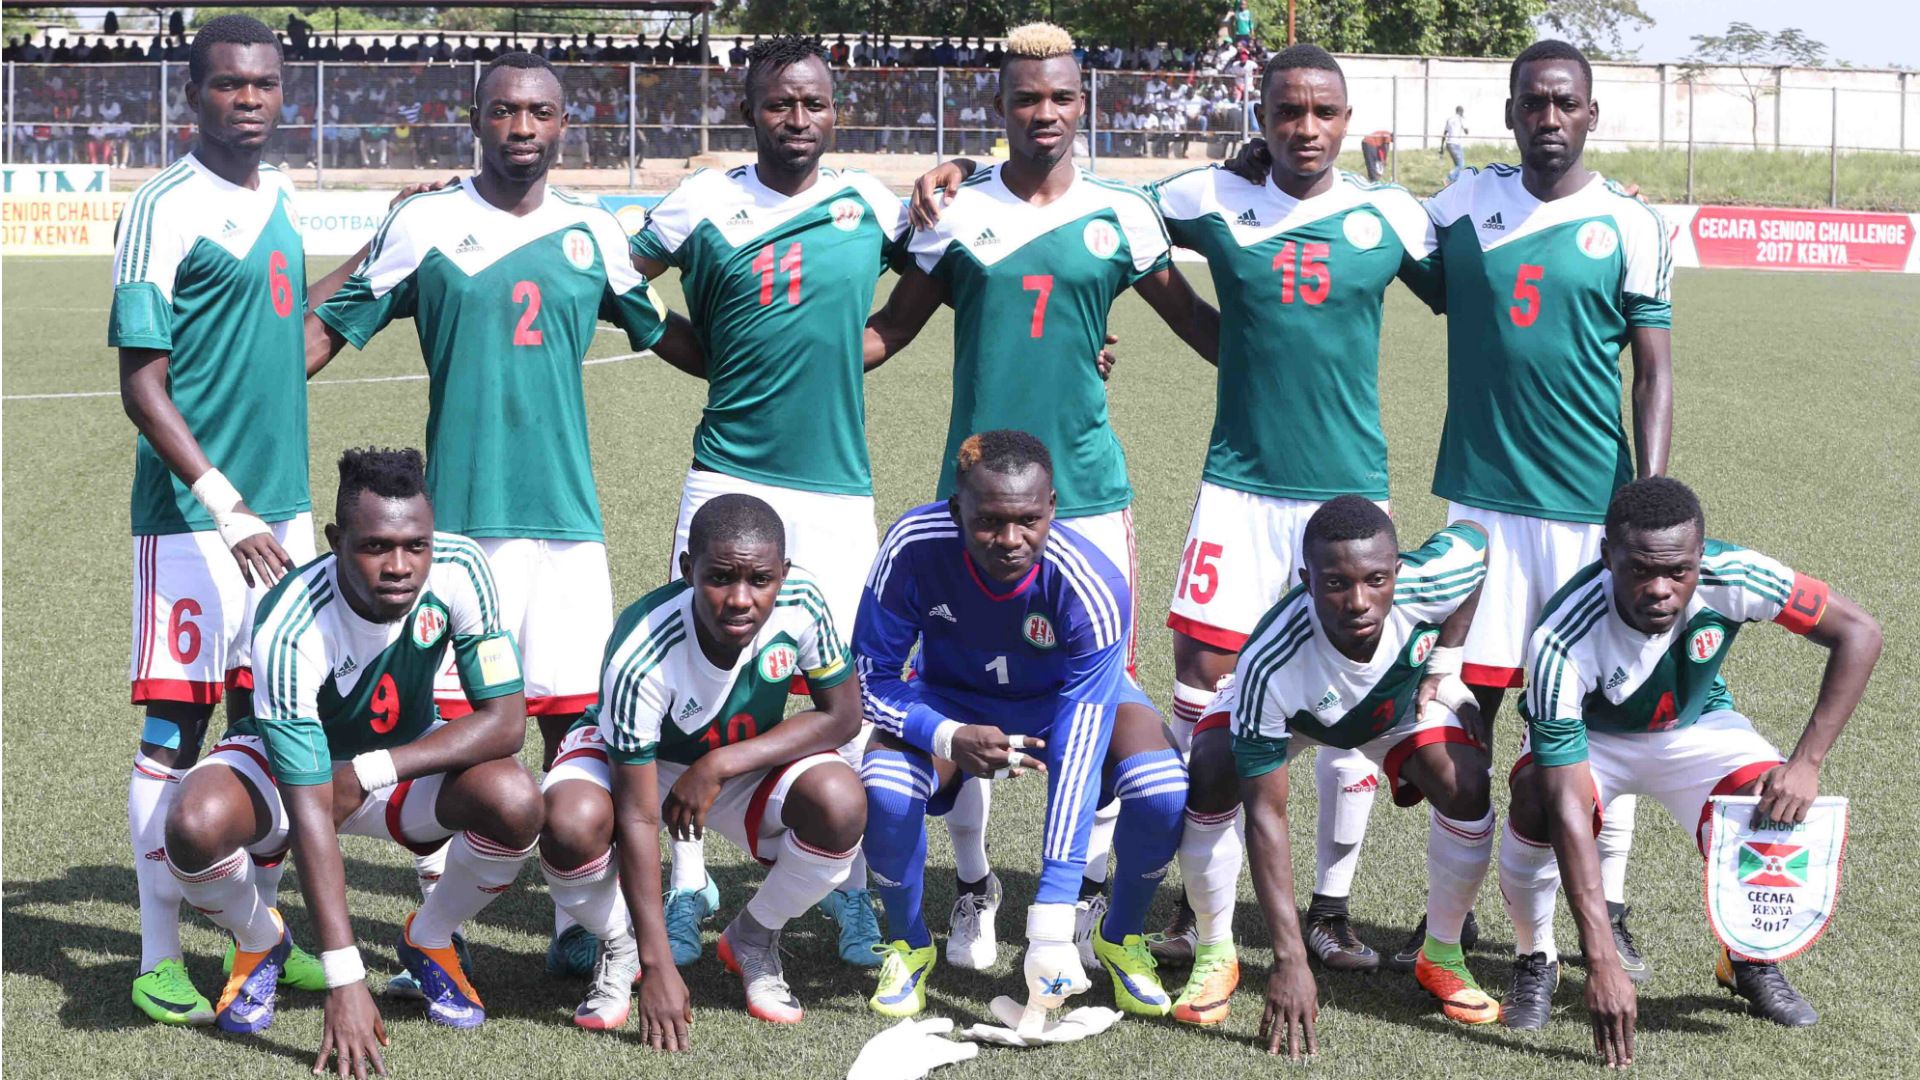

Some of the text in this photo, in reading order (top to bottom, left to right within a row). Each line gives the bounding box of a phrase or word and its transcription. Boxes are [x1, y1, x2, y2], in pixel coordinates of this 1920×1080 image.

[34, 225, 89, 245] KENYA
[1482, 223, 1505, 231] adidas
[1699, 217, 1906, 245] CECAFA SENIOR CHALLENGE
[1756, 241, 1848, 264] 2017 KENYA
[269, 250, 293, 318] 6
[752, 242, 803, 305] 11
[1272, 240, 1331, 305] 15
[1022, 275, 1054, 338] 7
[1509, 264, 1544, 328] 5
[512, 280, 543, 346] 2
[1178, 538, 1223, 604] 15
[928, 610, 957, 623] adidas
[1794, 589, 1822, 617] C
[168, 597, 203, 665] 6
[985, 656, 1010, 684] 1
[369, 672, 400, 735] 9
[679, 706, 703, 721] adidas
[1747, 891, 1795, 904] CECAFA
[1752, 904, 1793, 916] KENYA
[1751, 917, 1789, 932] 2017
